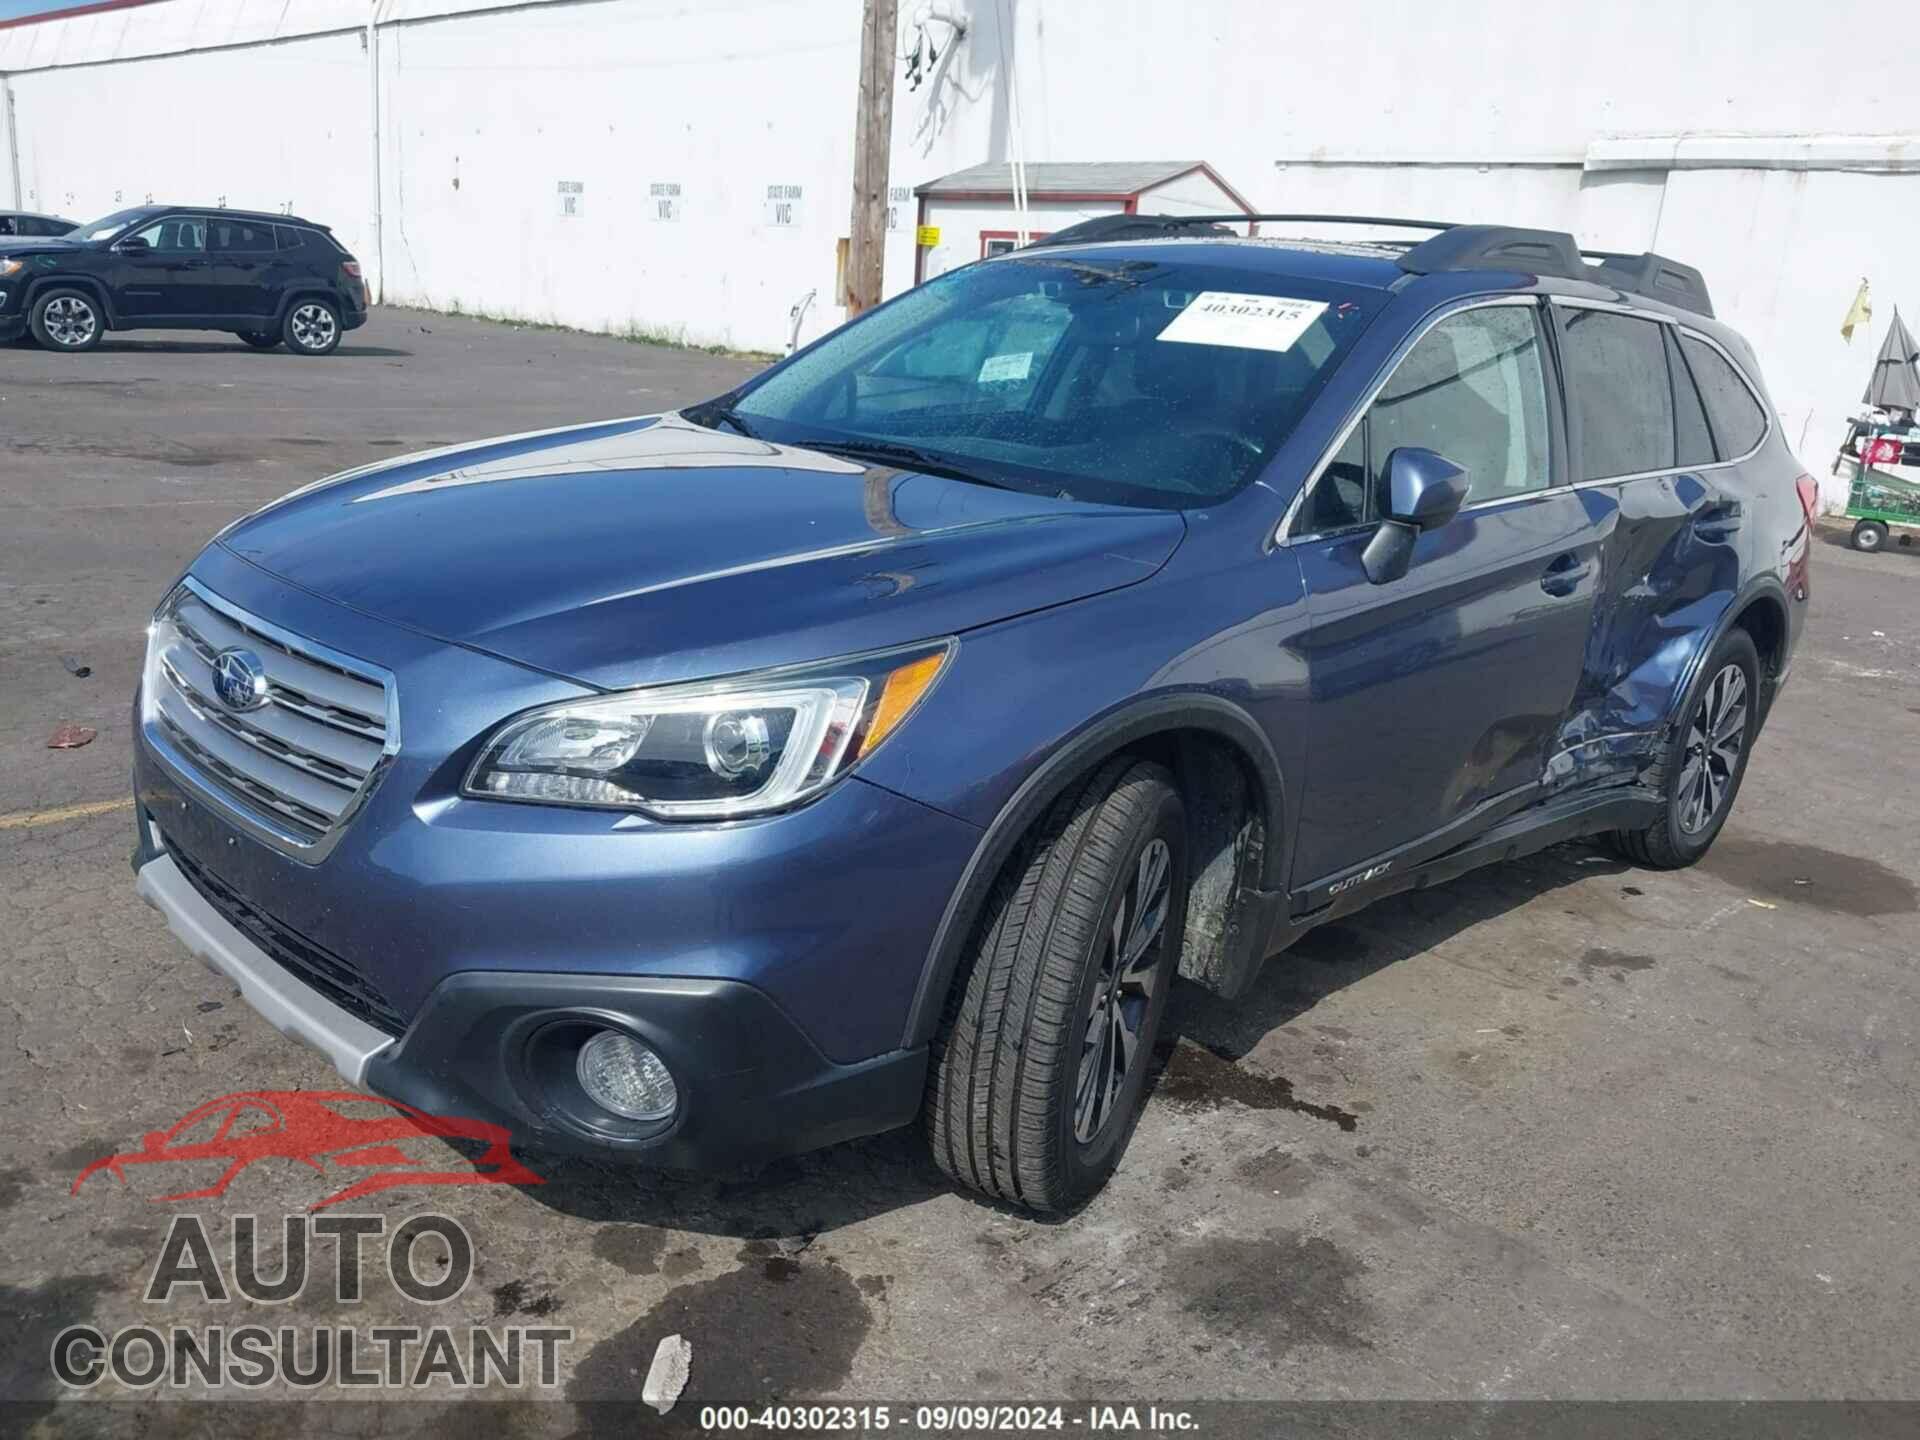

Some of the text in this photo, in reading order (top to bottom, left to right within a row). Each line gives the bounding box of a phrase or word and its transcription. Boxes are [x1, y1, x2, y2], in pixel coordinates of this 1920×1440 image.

[775, 203, 792, 224] VIC
[886, 207, 898, 229] IC
[1200, 303, 1303, 321] 40302315
